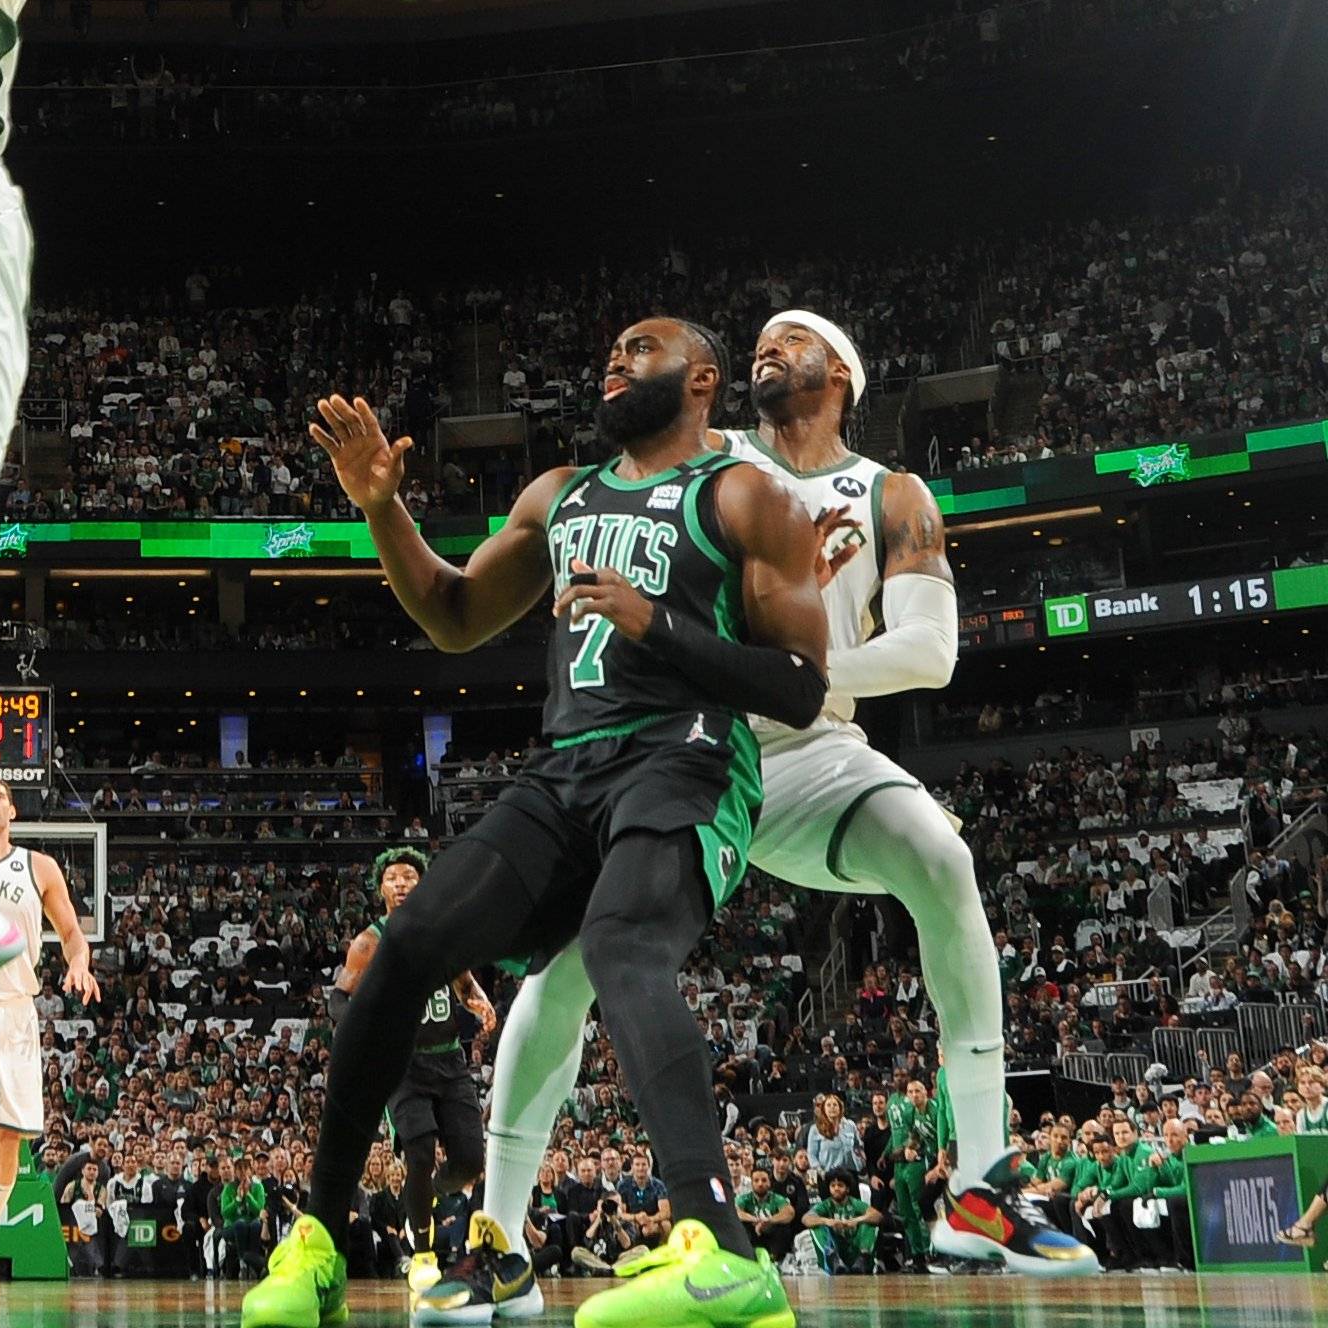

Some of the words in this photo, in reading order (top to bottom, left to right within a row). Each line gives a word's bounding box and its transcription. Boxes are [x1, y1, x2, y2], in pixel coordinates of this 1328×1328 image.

[1050, 602, 1085, 629] TD
[1093, 592, 1160, 619] Bank
[1188, 577, 1269, 616] 1:15
[569, 599, 616, 690] 7
[131, 1225, 155, 1242] TD
